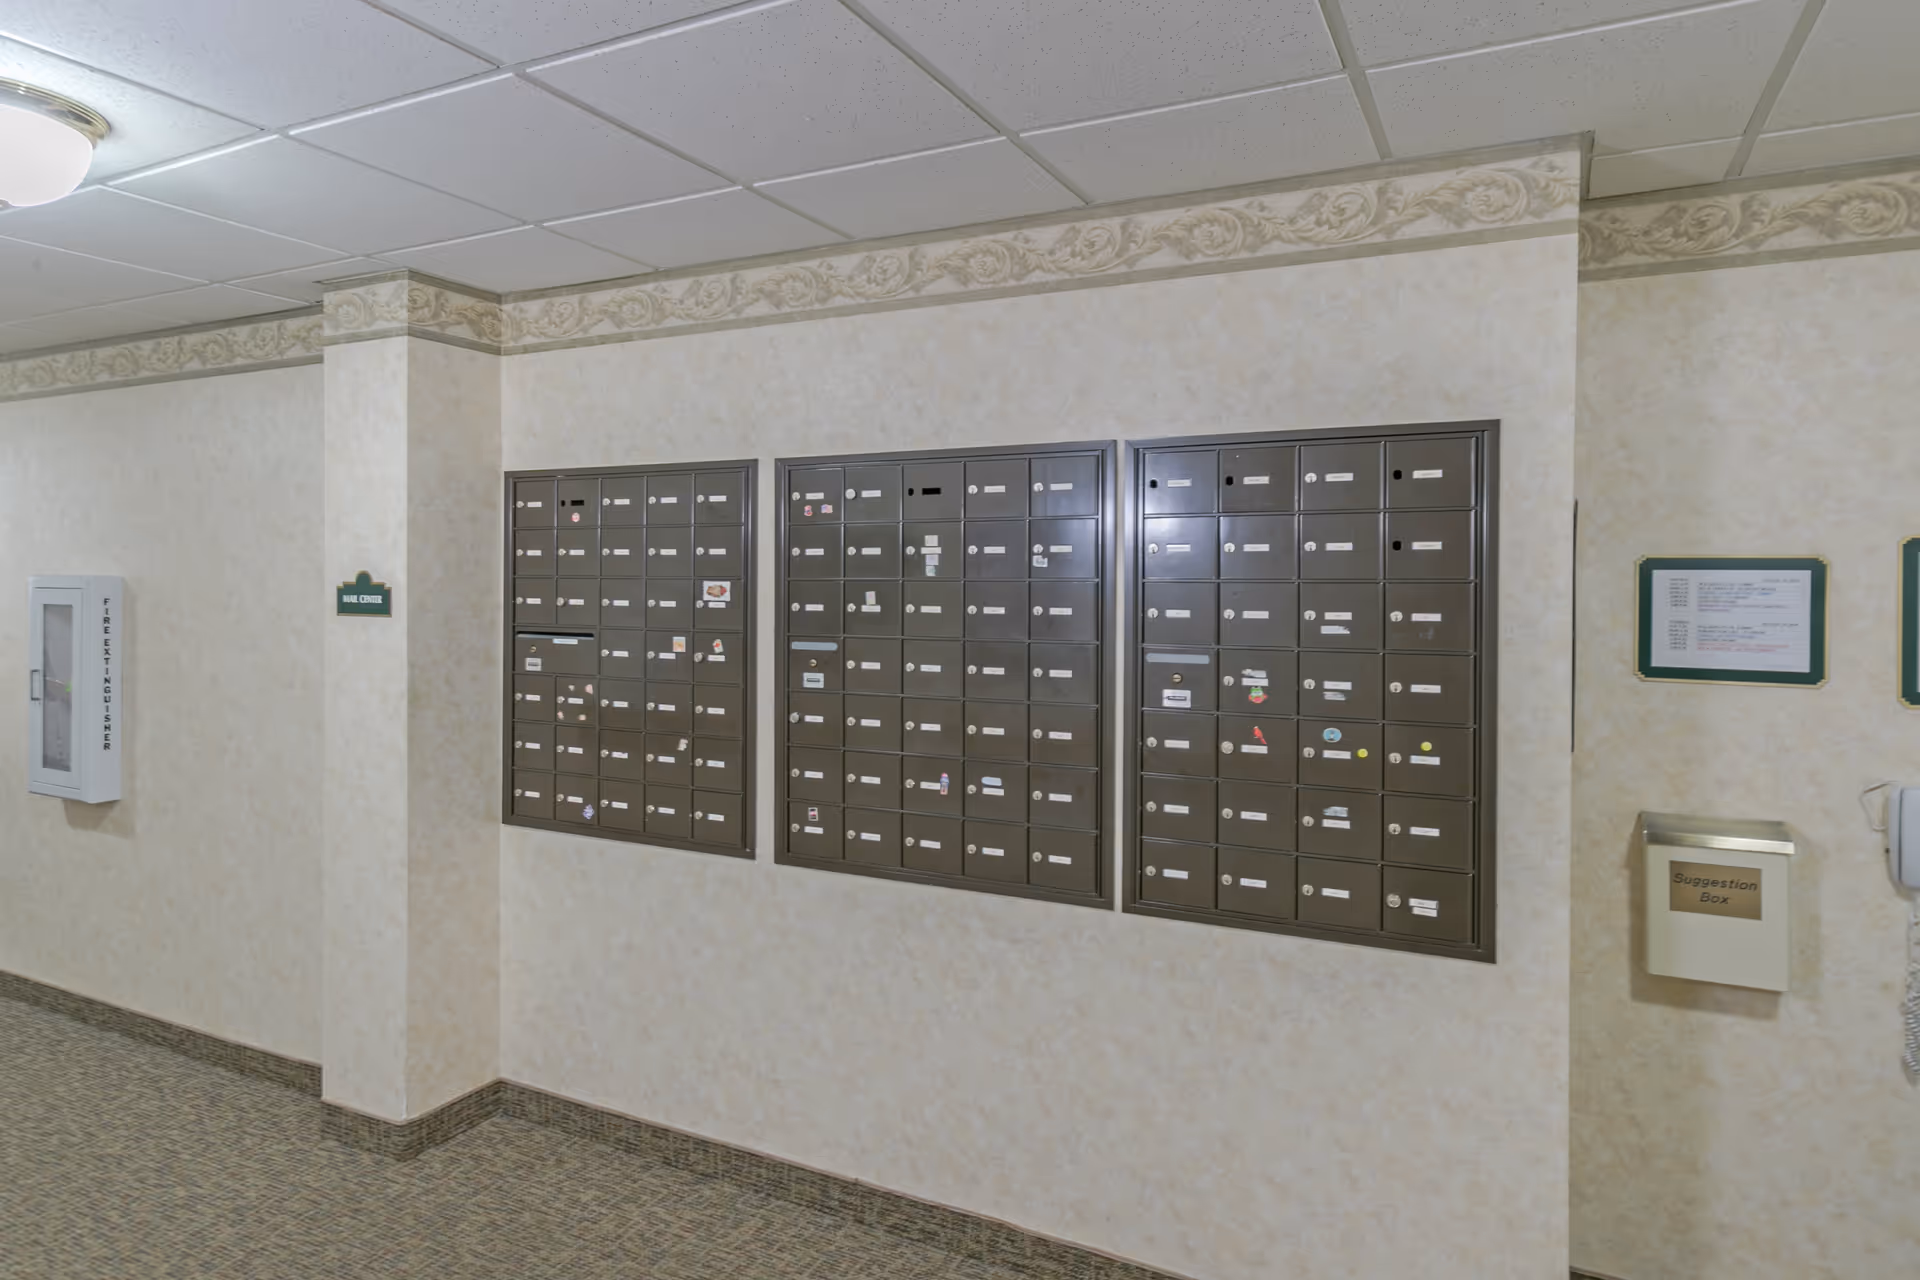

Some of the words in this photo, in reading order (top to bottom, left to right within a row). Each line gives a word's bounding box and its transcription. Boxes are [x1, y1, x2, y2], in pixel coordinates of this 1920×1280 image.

[342, 594, 359, 603] MAIL
[359, 595, 383, 604] CENTER
[103, 598, 111, 634] FIRE
[103, 638, 112, 751] EXTINGUISHER
[1673, 872, 1758, 892] Suggestion
[1699, 892, 1730, 905] Box
